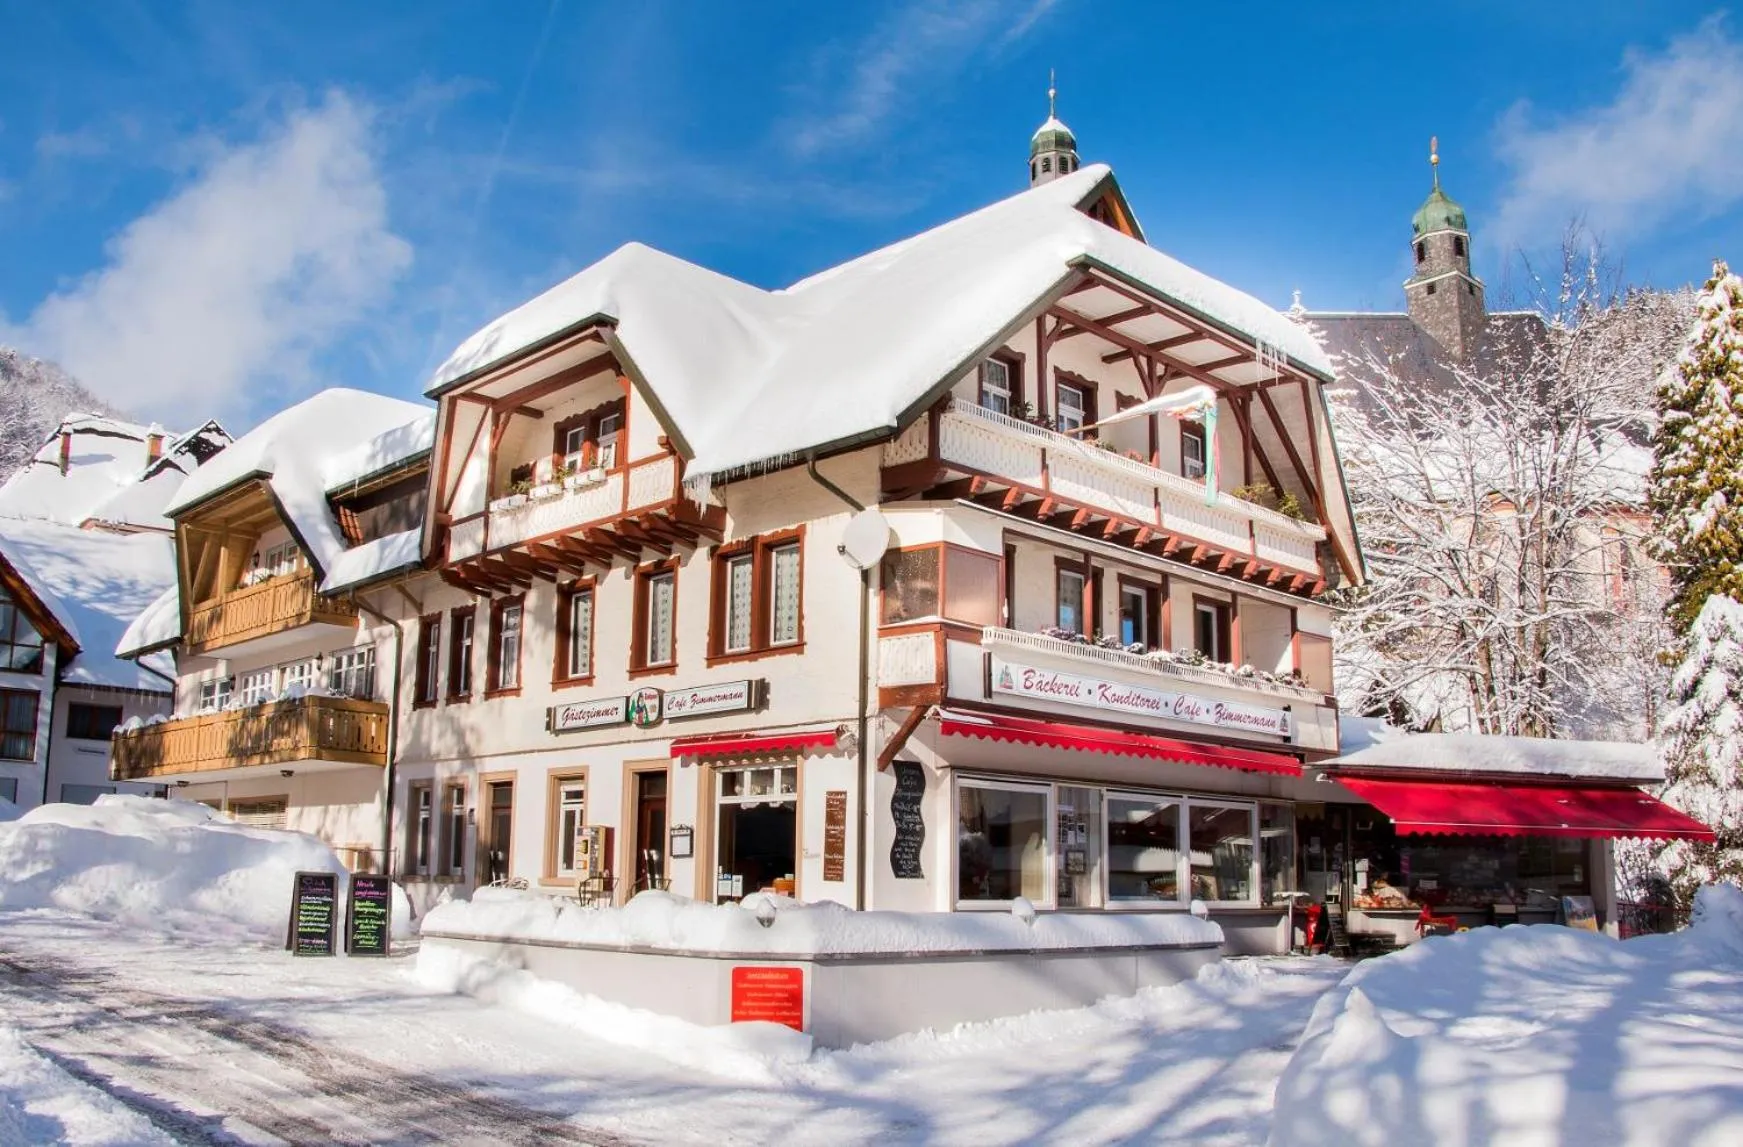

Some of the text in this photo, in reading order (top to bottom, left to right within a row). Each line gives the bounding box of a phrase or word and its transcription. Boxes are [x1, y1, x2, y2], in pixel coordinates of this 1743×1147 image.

[690, 691, 744, 709] Zimmermann
[1022, 668, 1081, 697] Bäckerei
[1098, 683, 1160, 711] Konditorei
[1214, 703, 1277, 728] Zimmermann
[562, 706, 619, 727] Gästezimmer
